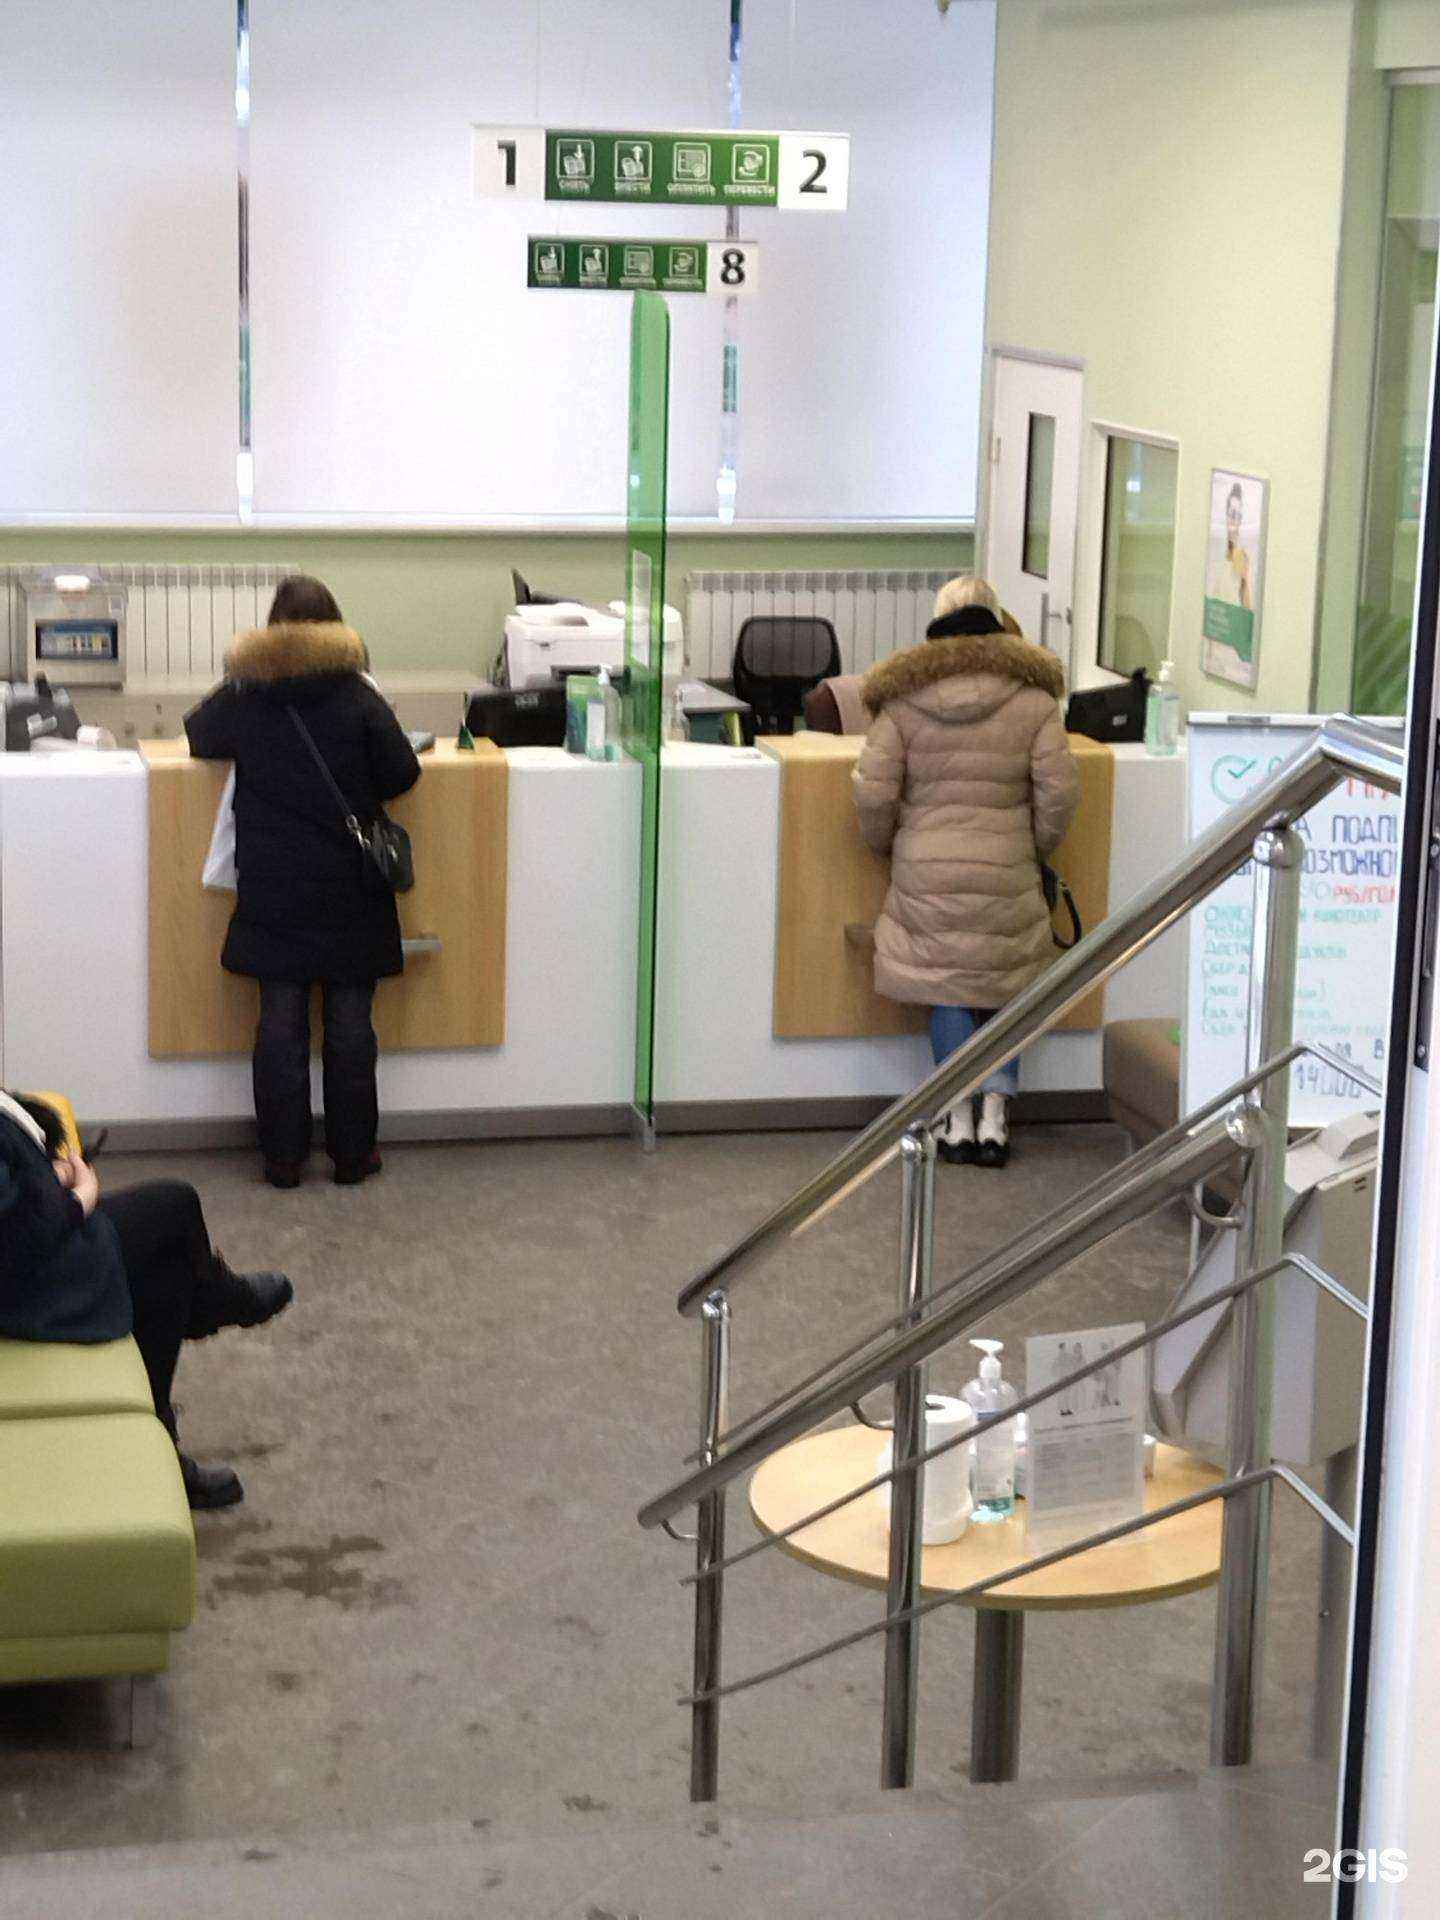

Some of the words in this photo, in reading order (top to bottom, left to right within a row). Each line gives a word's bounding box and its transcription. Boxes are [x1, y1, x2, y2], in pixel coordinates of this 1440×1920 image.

[497, 140, 516, 186] 1
[800, 150, 828, 194] 2
[719, 249, 745, 285] 8
